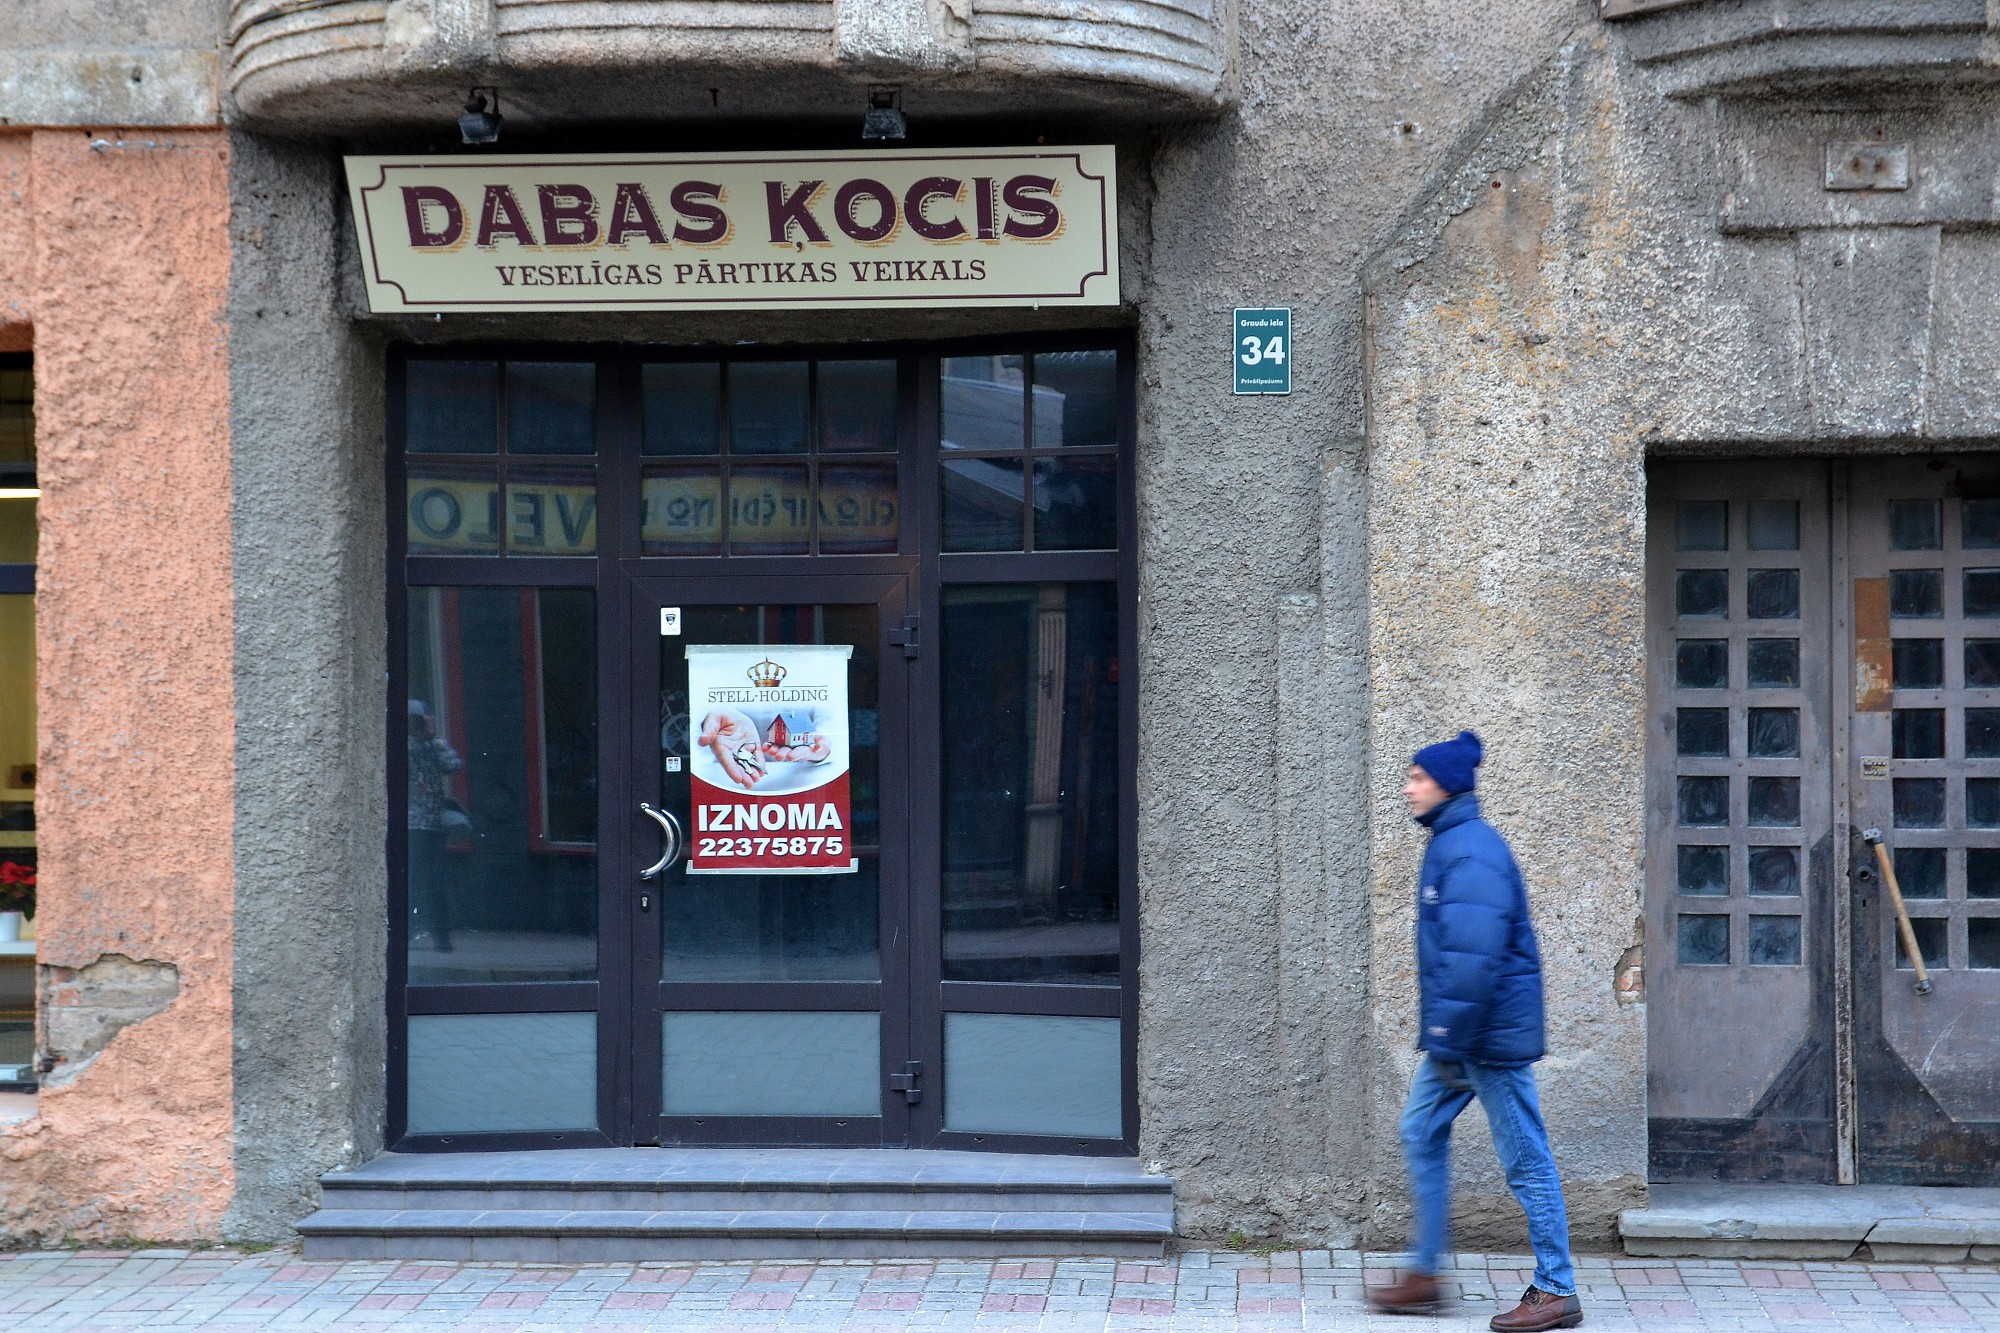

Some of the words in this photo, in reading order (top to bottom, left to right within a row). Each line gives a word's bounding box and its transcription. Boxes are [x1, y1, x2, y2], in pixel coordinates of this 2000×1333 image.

[399, 181, 734, 251] DABAS
[763, 175, 1064, 252] ĶOCIS
[496, 260, 662, 286] VESELĪGAS
[674, 259, 837, 284] PĀRTIKAS
[849, 259, 986, 281] VEIKALS
[1241, 319, 1269, 327] Graudu
[1270, 318, 1284, 327] iela
[1241, 335, 1286, 365] 34
[708, 689, 829, 703] STELL-HOLDING
[698, 803, 843, 832] IZNOMA
[699, 837, 844, 857] 22375875
